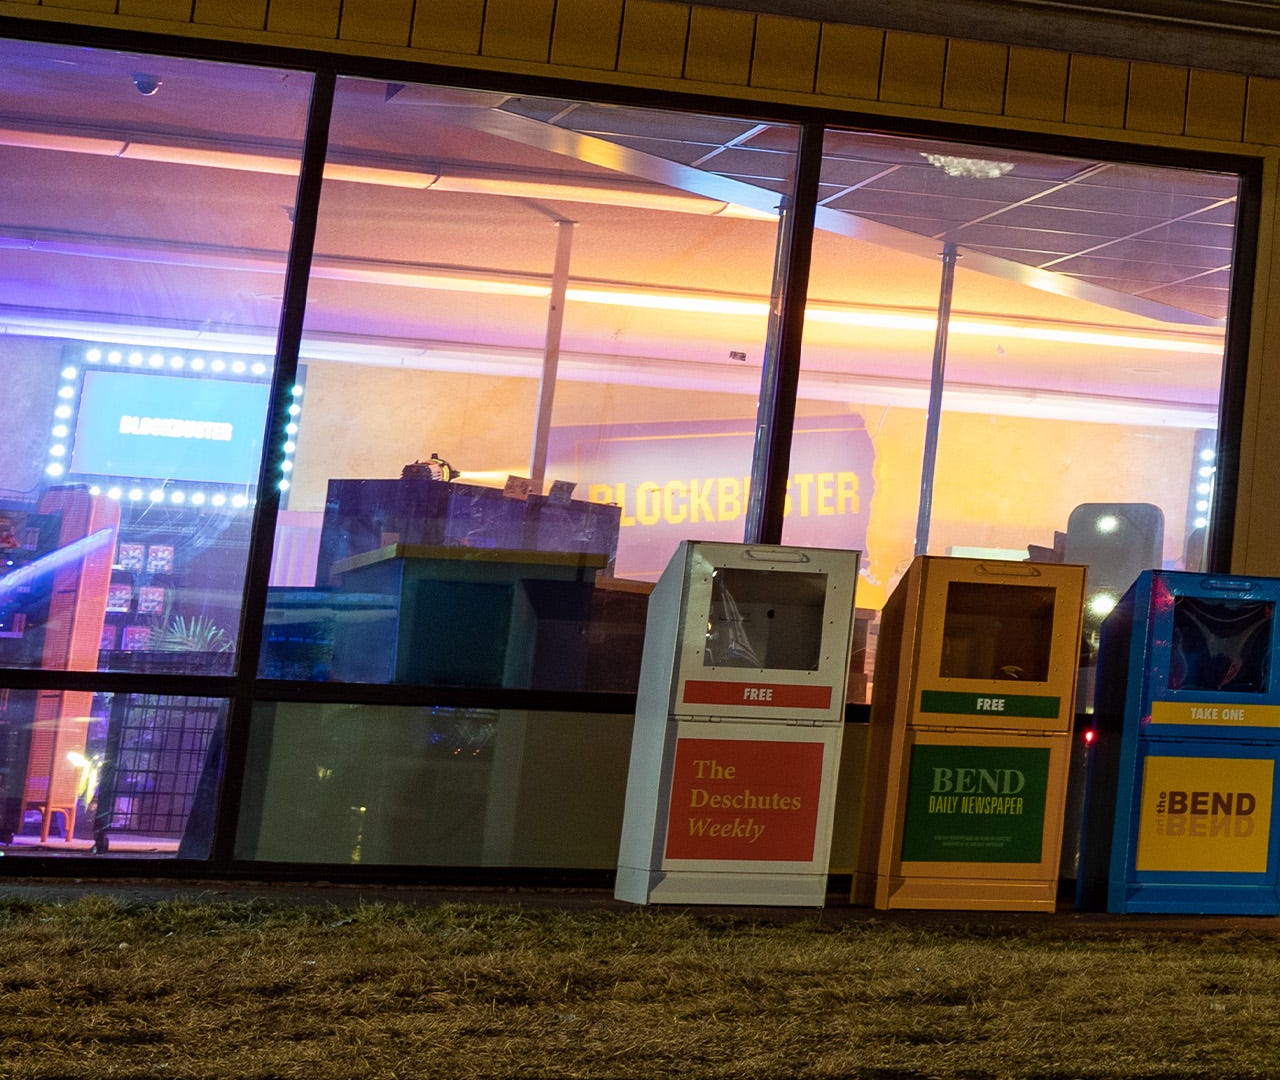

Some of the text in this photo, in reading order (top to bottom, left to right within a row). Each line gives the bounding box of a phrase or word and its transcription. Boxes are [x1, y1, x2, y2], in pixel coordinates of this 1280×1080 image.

[588, 471, 861, 527] BLOCKBSTER
[743, 687, 773, 702] FREE
[976, 697, 1005, 712] FREE
[1191, 707, 1245, 721] TAKE ONE
[693, 759, 736, 780] The
[930, 767, 1026, 795] BEND
[689, 788, 801, 811] Deschutes
[928, 795, 1024, 815] DAILY NEWSPAPER
[1156, 791, 1257, 816] the BEND
[688, 817, 765, 844] Weekly
